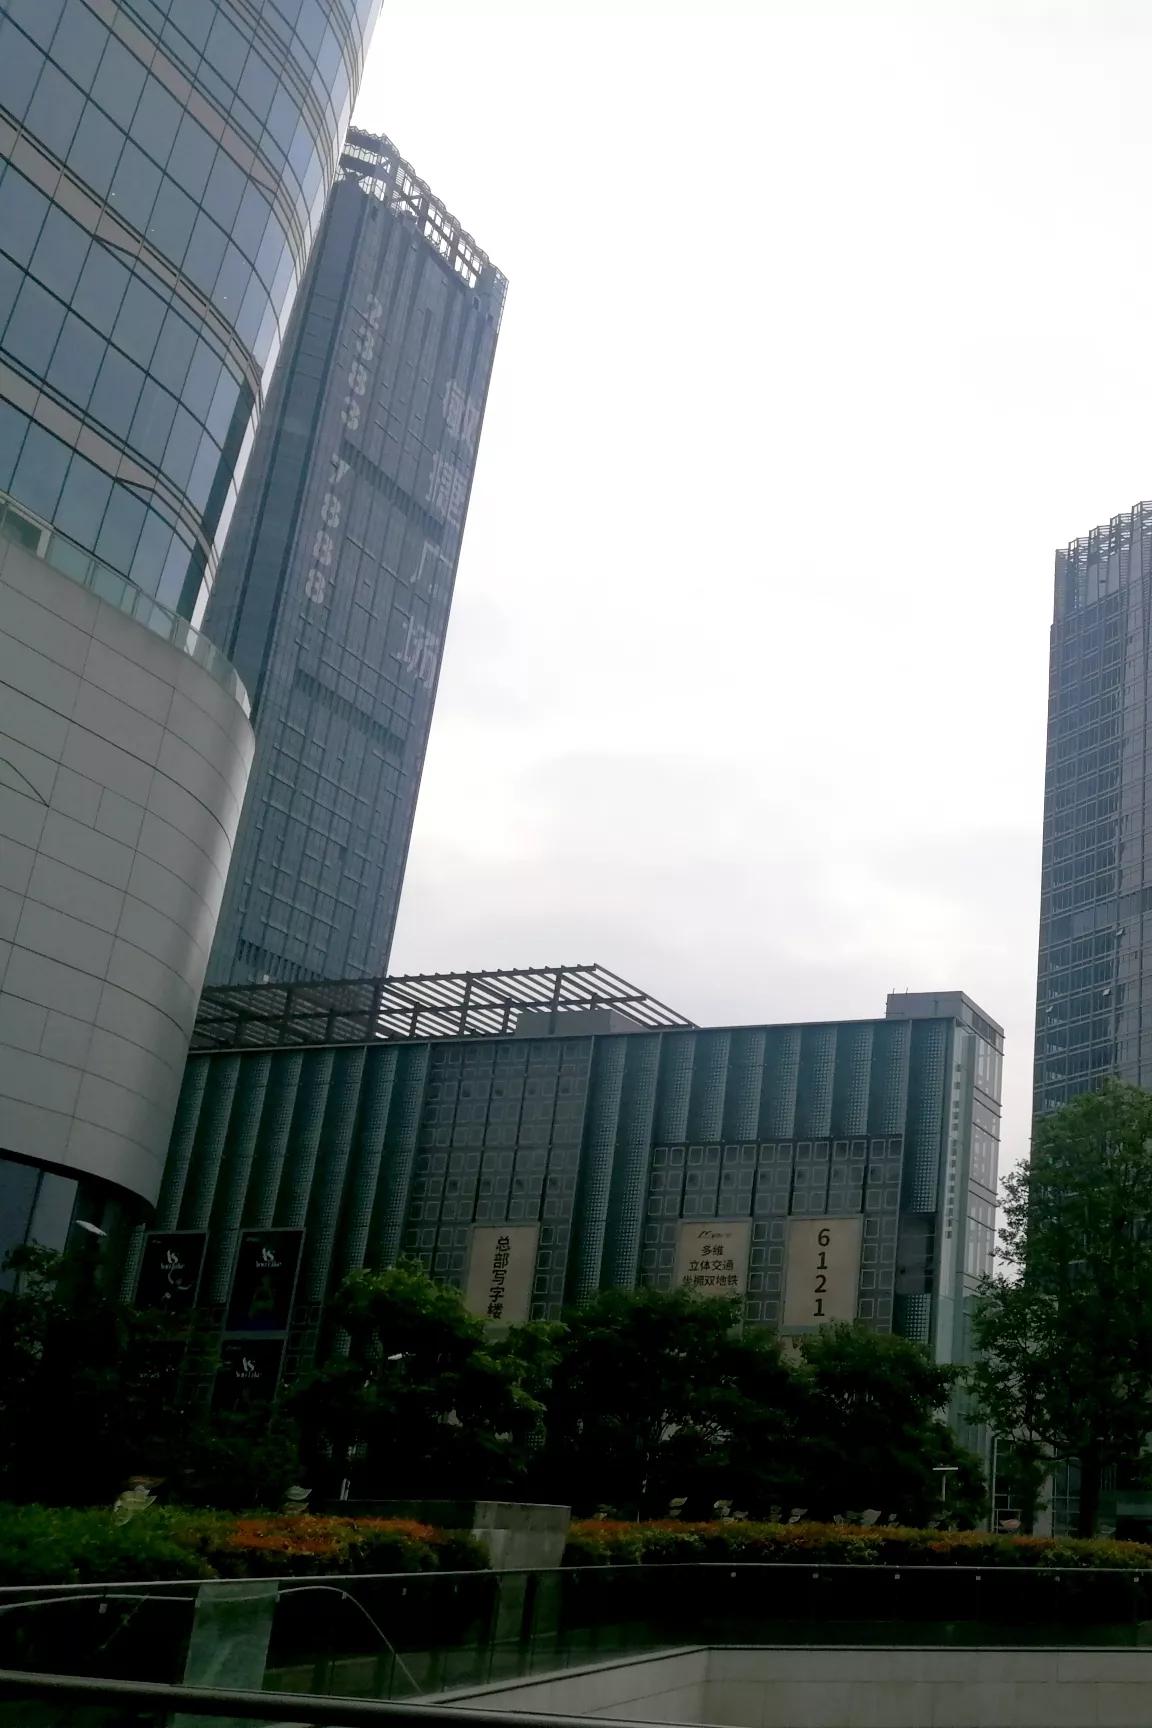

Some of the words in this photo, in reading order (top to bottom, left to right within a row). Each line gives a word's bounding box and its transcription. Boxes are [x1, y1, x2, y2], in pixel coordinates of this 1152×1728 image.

[688, 1260, 734, 1272] 立体交通
[701, 1244, 724, 1256] 多维
[813, 1228, 831, 1317] 6121
[487, 1235, 511, 1319] 总部写字楼
